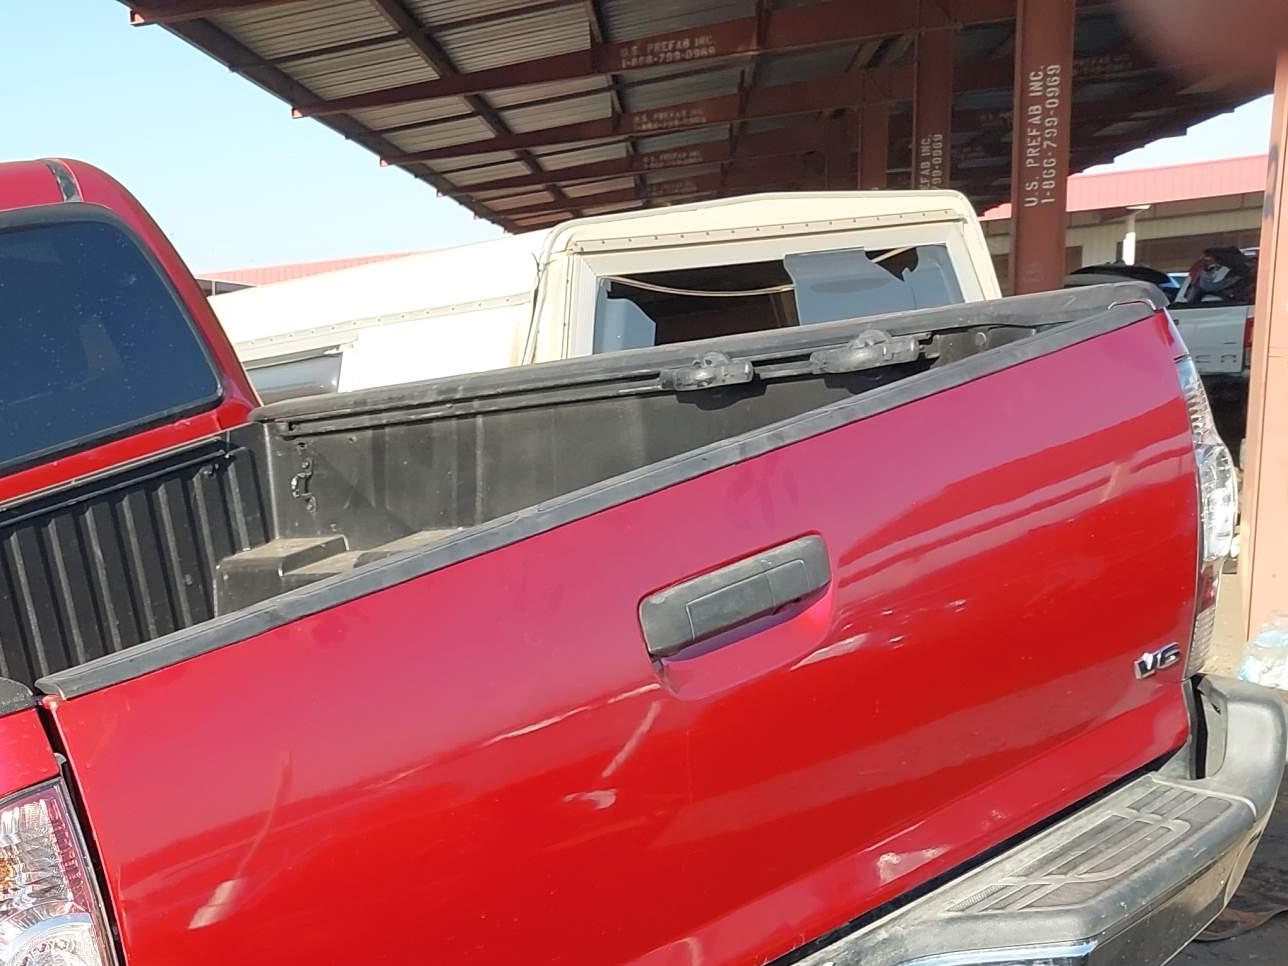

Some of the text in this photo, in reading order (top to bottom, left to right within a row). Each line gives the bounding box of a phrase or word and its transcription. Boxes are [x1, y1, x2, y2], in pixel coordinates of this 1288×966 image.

[1024, 65, 1045, 207] U.S. PREFAB INC.
[1134, 641, 1181, 680] V6
